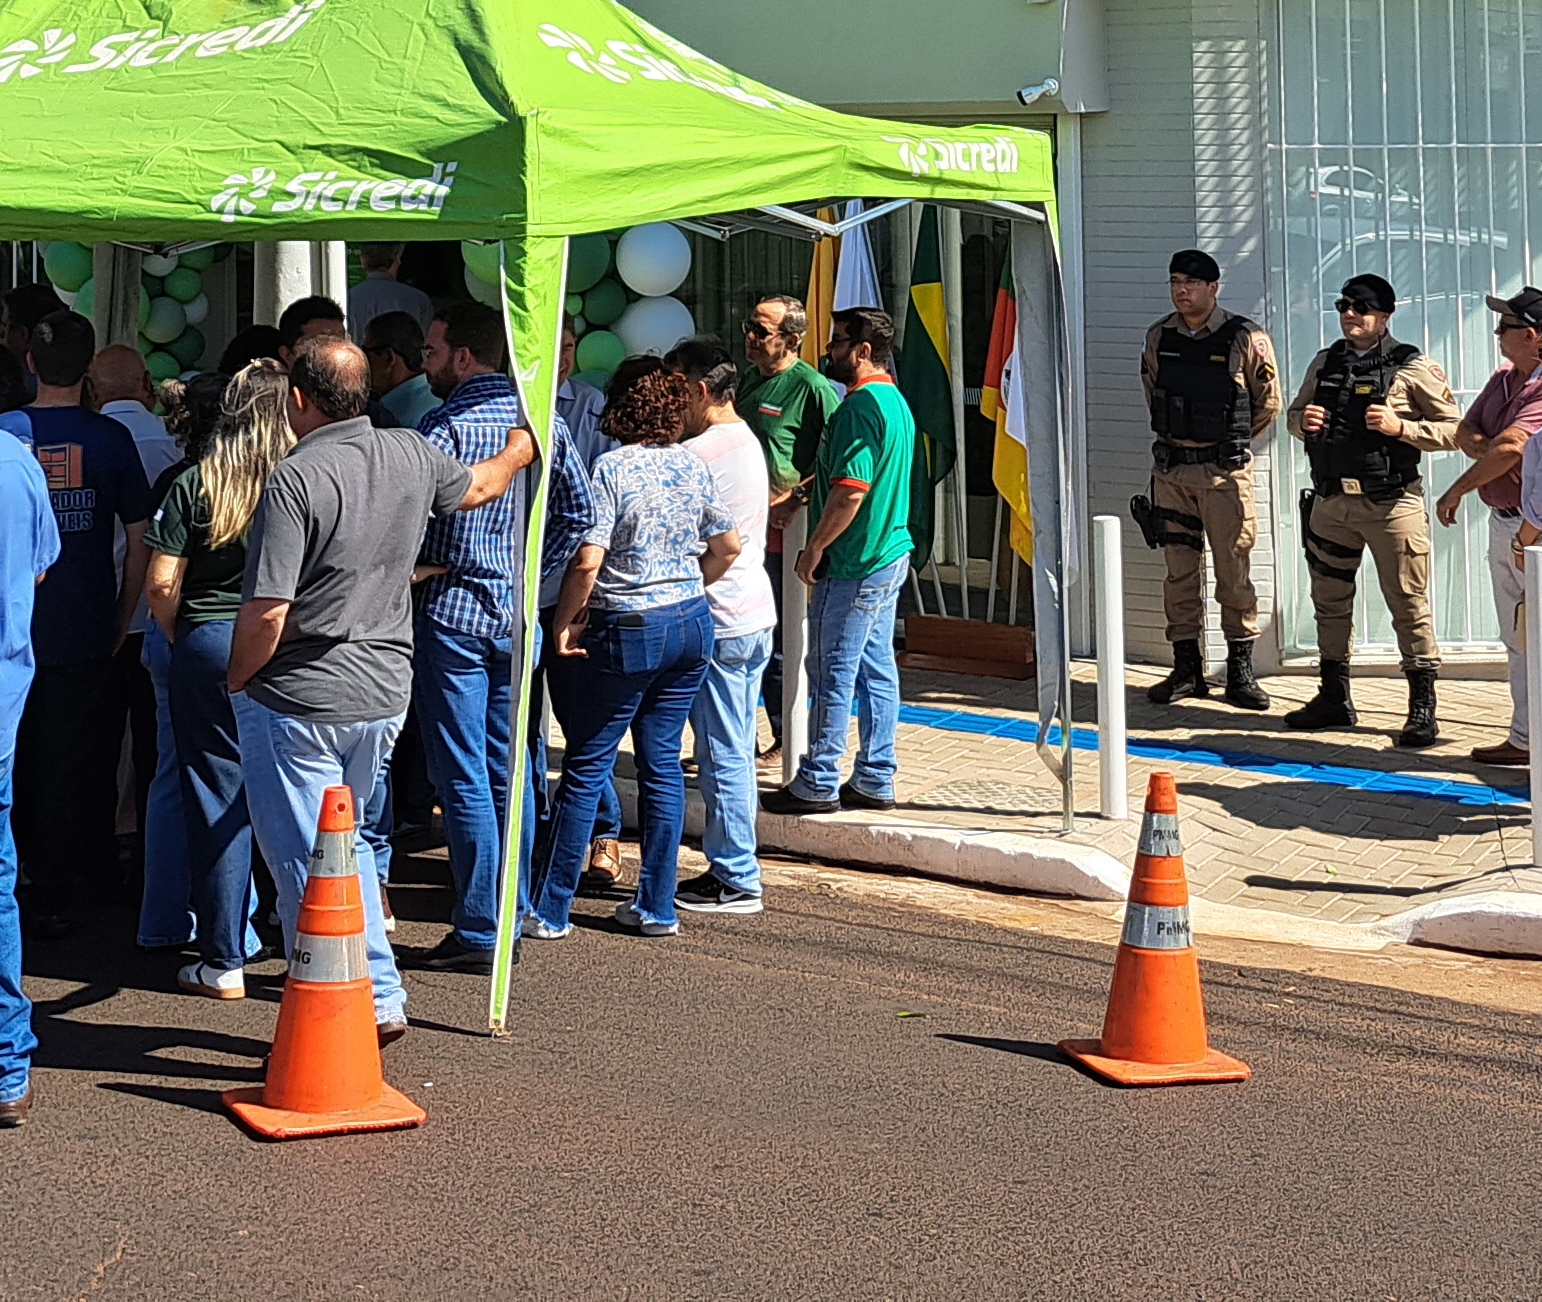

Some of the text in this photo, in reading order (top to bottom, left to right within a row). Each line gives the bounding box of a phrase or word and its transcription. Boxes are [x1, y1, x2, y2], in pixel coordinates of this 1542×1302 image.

[923, 136, 1018, 174] Sicredi
[271, 161, 458, 212] Sicredi
[50, 489, 95, 510] ADOR
[56, 511, 94, 532] VEIS
